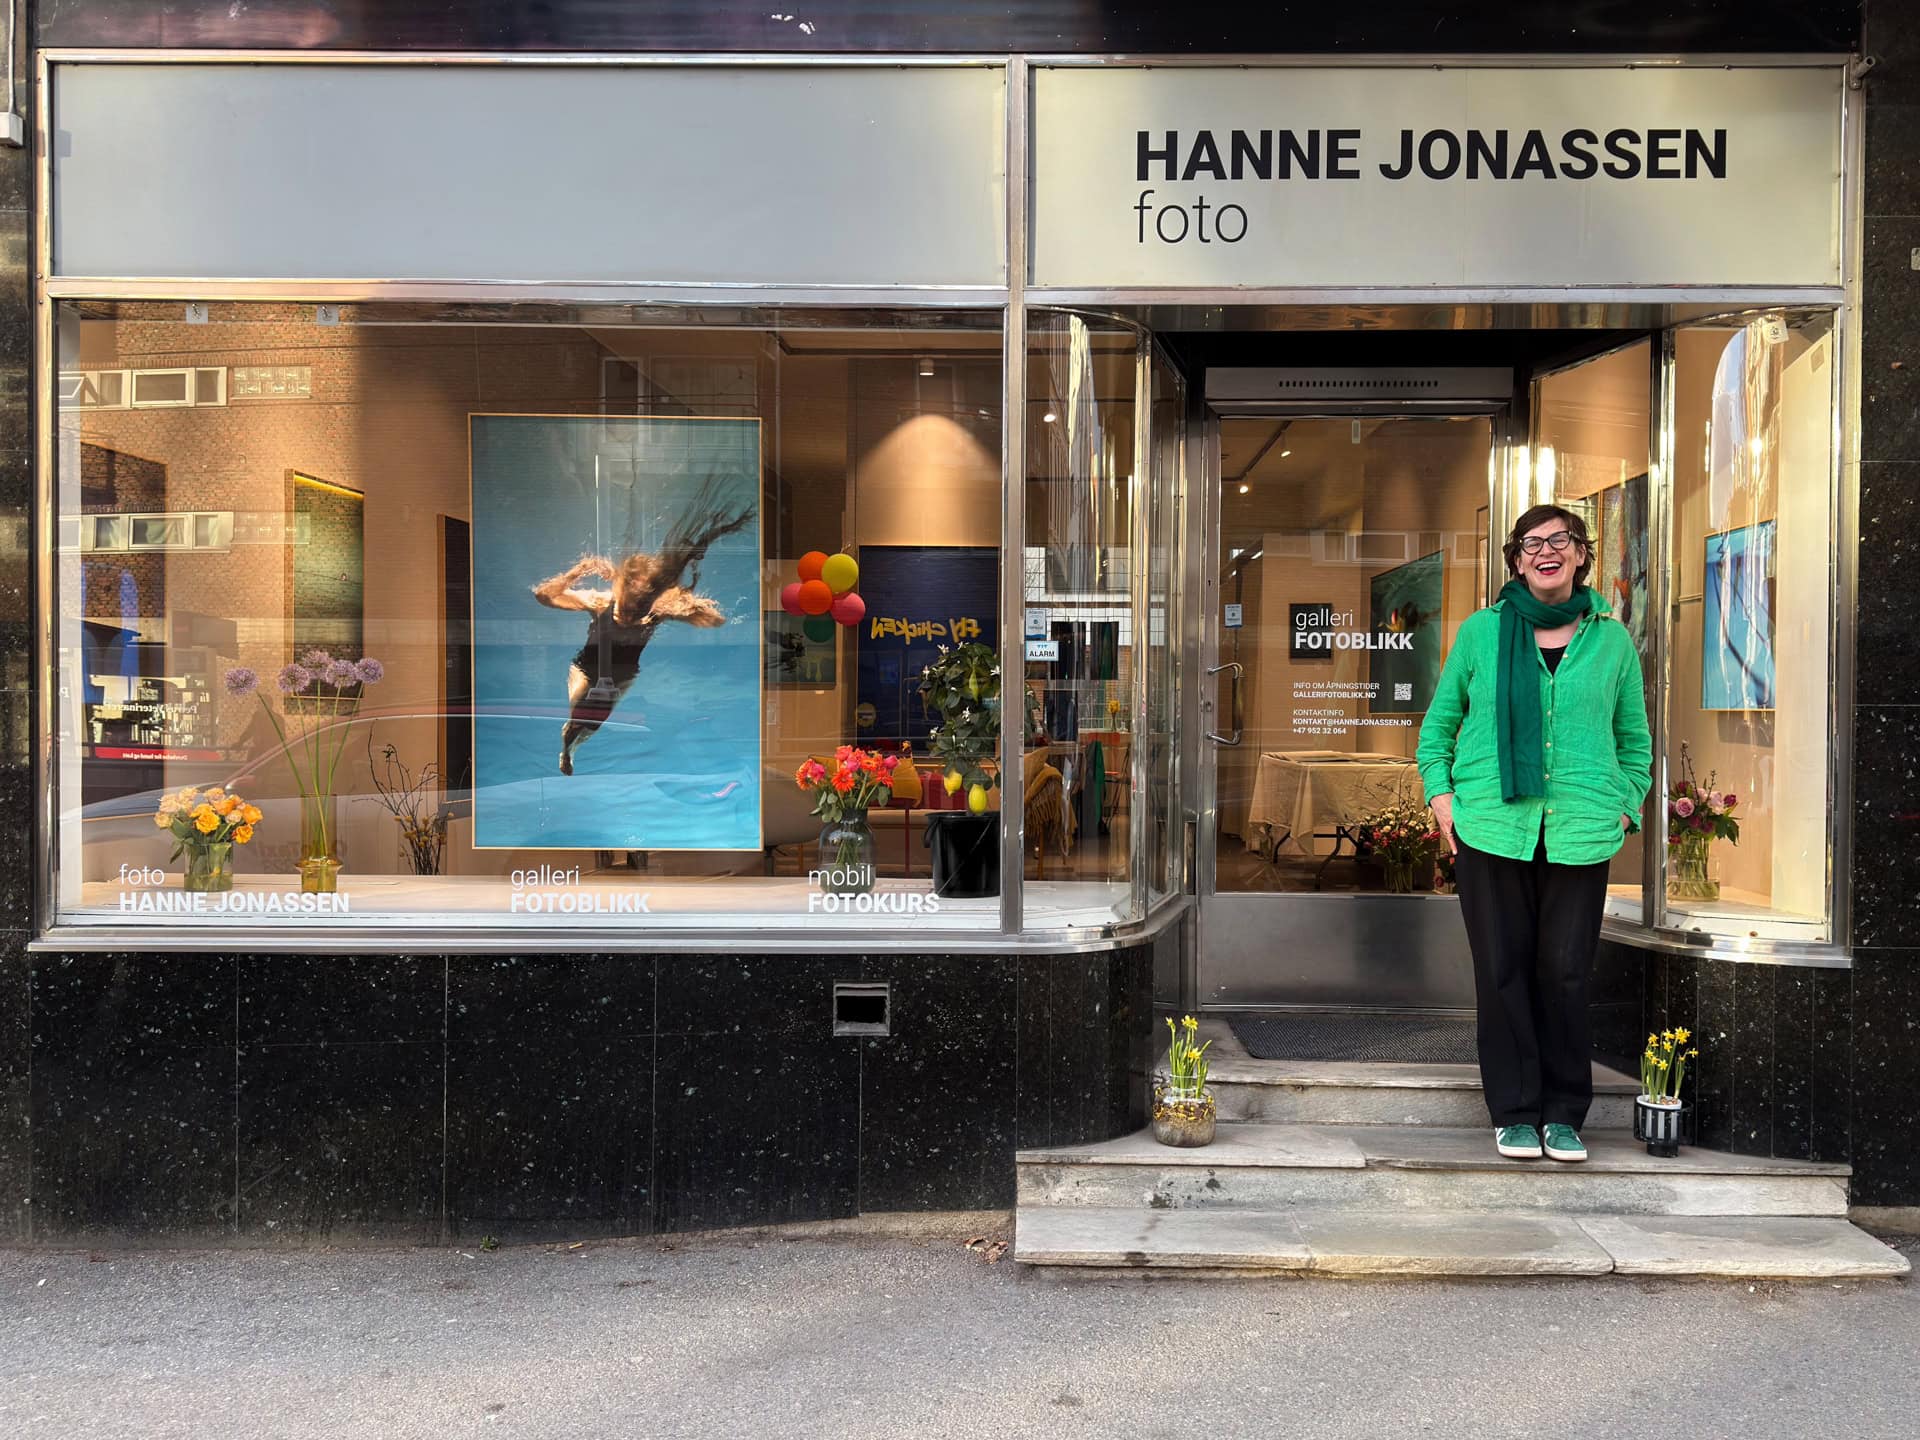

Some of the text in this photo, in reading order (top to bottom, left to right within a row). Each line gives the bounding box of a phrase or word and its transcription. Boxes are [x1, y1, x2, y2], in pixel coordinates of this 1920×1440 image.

[1136, 129, 1727, 181] HANNE JONASSEN
[1133, 190, 1248, 243] foto
[1295, 608, 1353, 630] galleri
[1295, 632, 1414, 650] FOTOBLIKK
[1029, 650, 1055, 658] ALARM
[1293, 682, 1380, 690] INFO OM ÅPNINGSTIDER
[1293, 691, 1376, 699] GALLERIFOTOBLIKK.NO
[1293, 709, 1344, 717] KONTAKTINFO
[1293, 718, 1412, 727] KONTAKT@HANNEJONASSEN.NO
[119, 864, 165, 885] foto
[510, 865, 580, 889] galleri
[808, 865, 871, 886] mobil
[119, 892, 349, 912] HANNE JONASSEN
[510, 893, 651, 913] FOTOBLIKK
[808, 893, 940, 913] FOTOKURS
